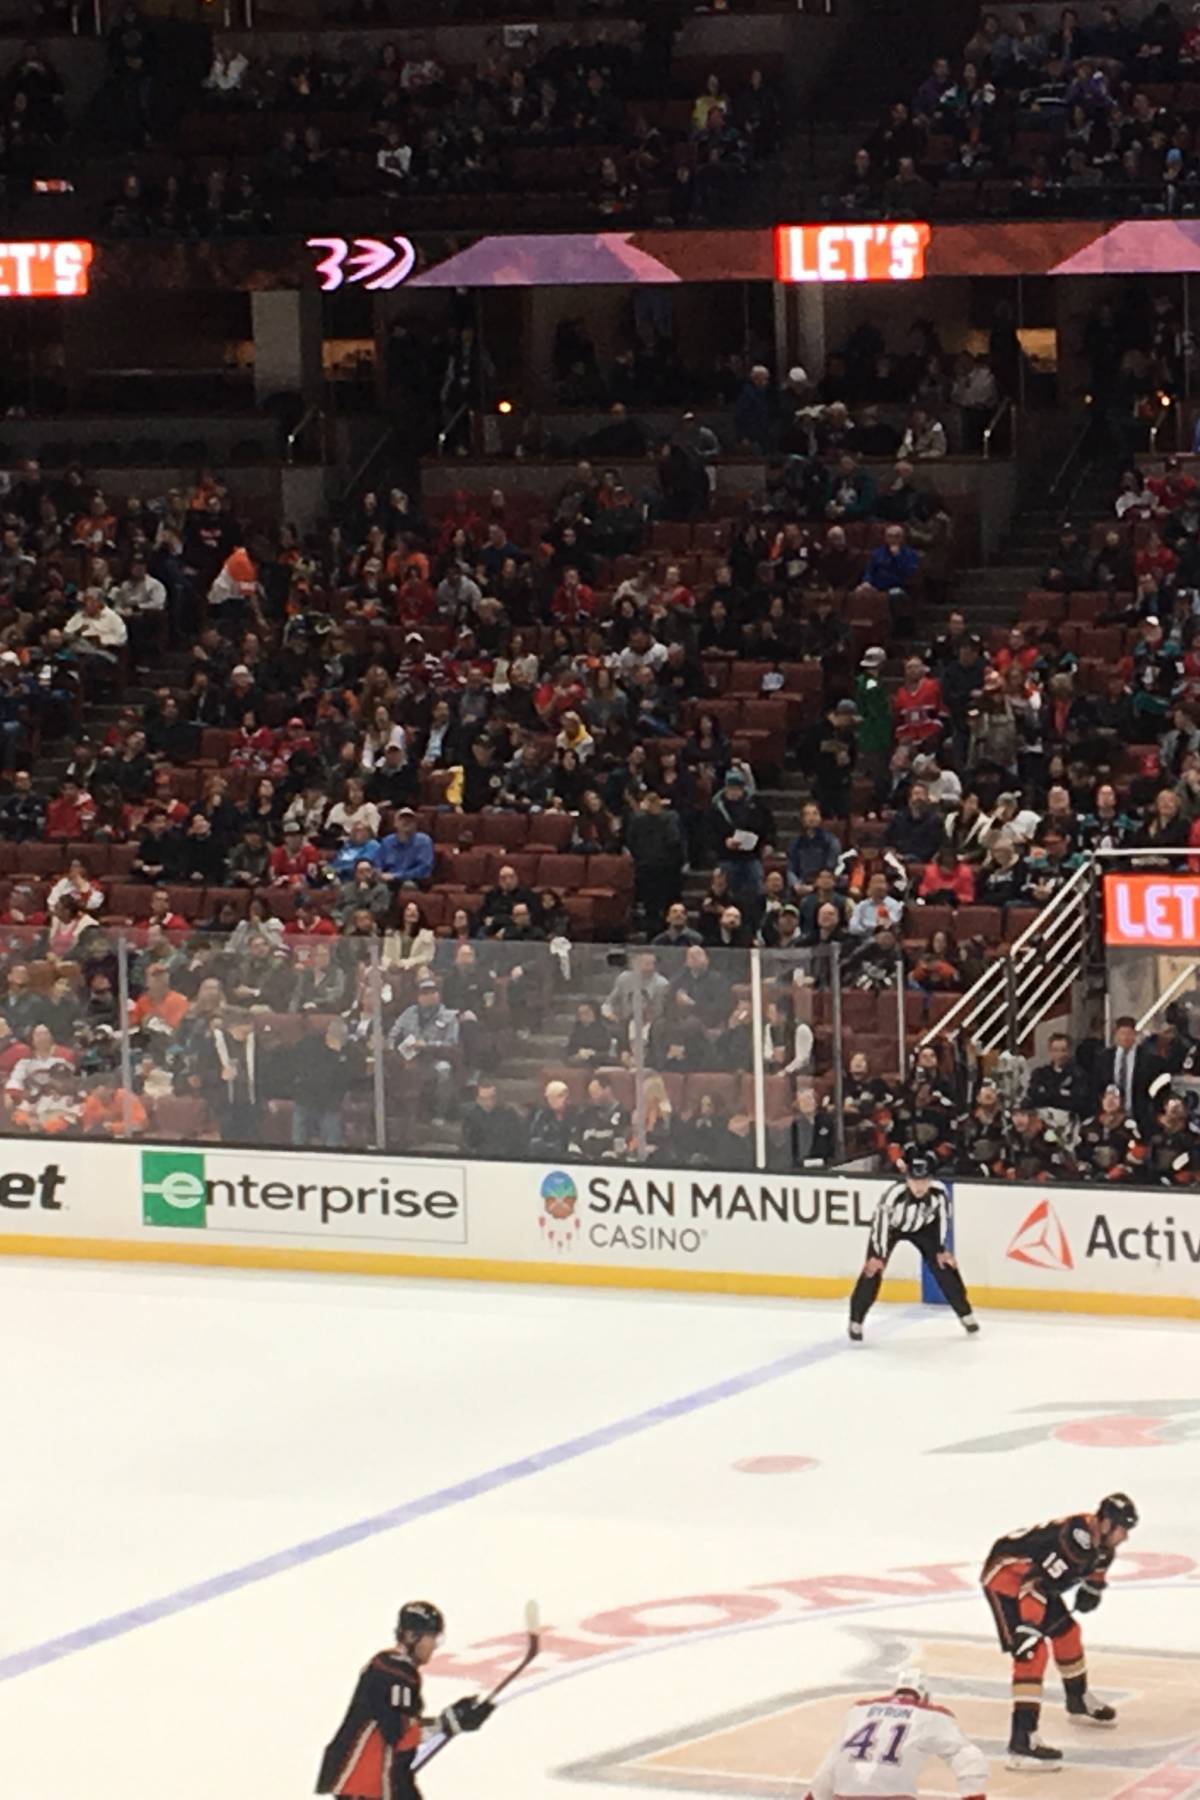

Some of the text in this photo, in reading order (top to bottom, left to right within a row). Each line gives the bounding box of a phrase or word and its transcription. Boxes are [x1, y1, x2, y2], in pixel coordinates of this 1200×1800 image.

[789, 223, 920, 282] LET'S
[159, 1171, 460, 1224] enterprise
[588, 1177, 873, 1228] SAN MANUEL
[589, 1223, 701, 1253] CASINO
[1041, 1551, 1069, 1580] 15
[390, 1683, 412, 1708] 11
[842, 1717, 914, 1767] 41
